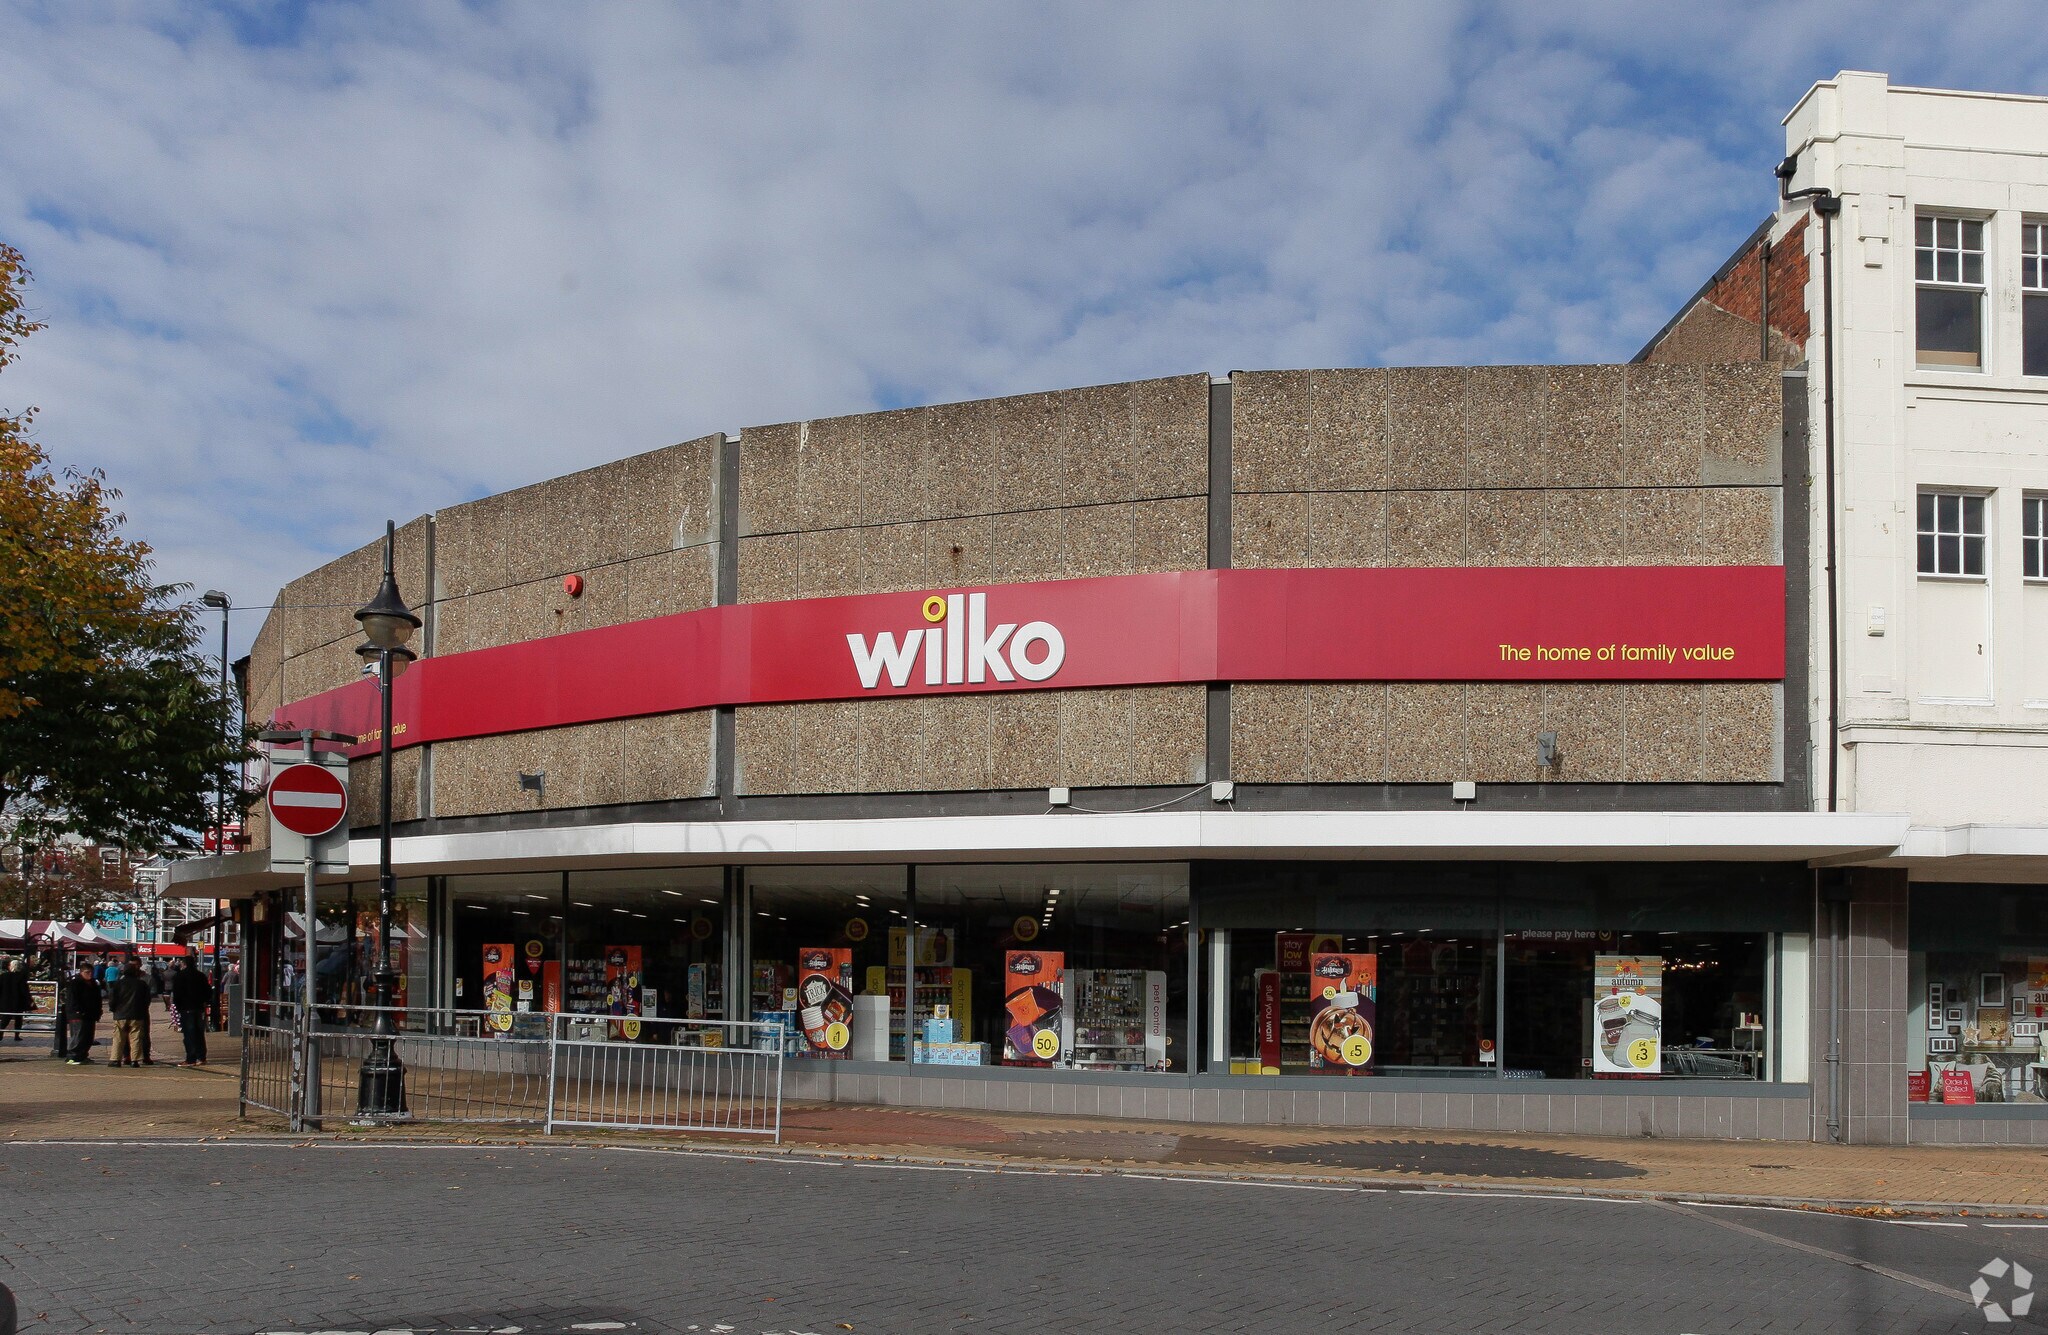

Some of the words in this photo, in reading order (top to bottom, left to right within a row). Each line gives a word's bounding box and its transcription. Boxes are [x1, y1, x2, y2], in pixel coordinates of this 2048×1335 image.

[845, 592, 1067, 689] wilko
[1499, 644, 1532, 661] The
[1537, 644, 1592, 661] home
[1597, 644, 1616, 661] of
[1621, 644, 1678, 664] family
[1682, 644, 1735, 661] value
[98, 918, 124, 928] Argos
[1522, 929, 1553, 940] please
[1555, 930, 1572, 941] pay
[1574, 929, 1596, 939] here
[1284, 940, 1303, 950] stay
[1283, 949, 1303, 959] low
[1283, 959, 1303, 968] price
[1611, 977, 1644, 986] autumn
[1152, 984, 1161, 1004] pest
[1265, 984, 1273, 1003] stuff
[1265, 1004, 1273, 1019] you
[1152, 1006, 1161, 1037] control
[832, 1031, 841, 1042] £1
[1265, 1020, 1274, 1043] want
[1036, 1038, 1056, 1051] 50p
[1349, 1045, 1362, 1057] £5
[1636, 1048, 1648, 1060] £3
[1944, 1078, 1963, 1086] Order
